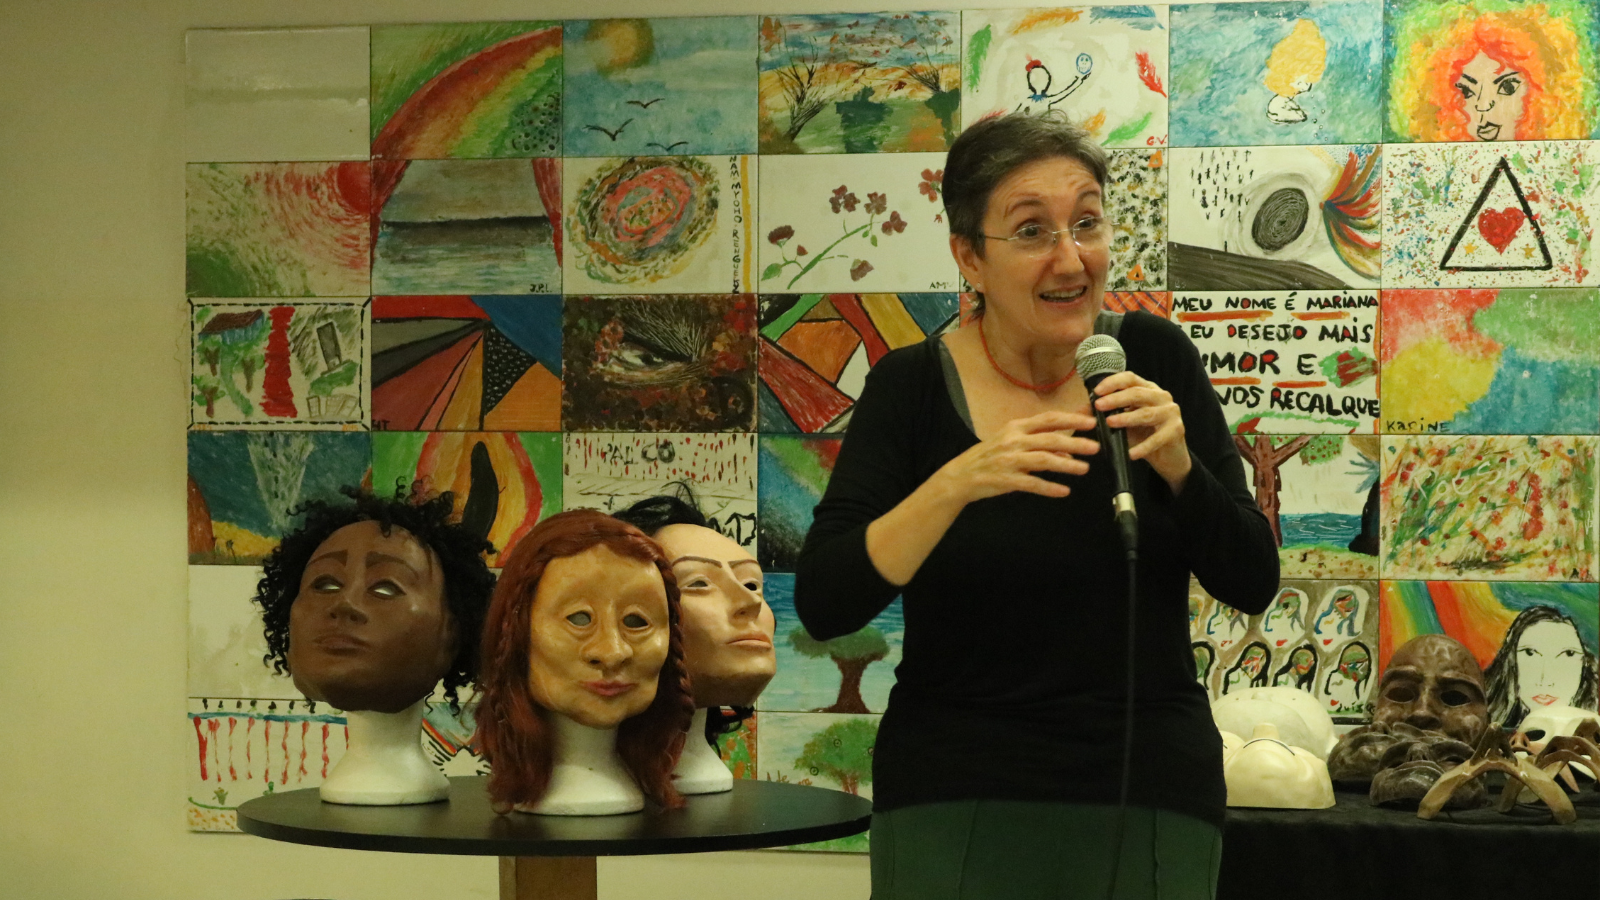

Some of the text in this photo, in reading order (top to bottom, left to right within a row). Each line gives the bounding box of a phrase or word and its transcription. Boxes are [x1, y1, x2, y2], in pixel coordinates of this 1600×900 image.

[1172, 296, 1213, 311] MEU
[1225, 296, 1277, 311] NOME
[1284, 291, 1297, 310] É
[1190, 324, 1214, 339] EU
[1228, 324, 1307, 342] DESEJO
[1297, 353, 1317, 375] E
[1270, 387, 1381, 418] RECALQUE
